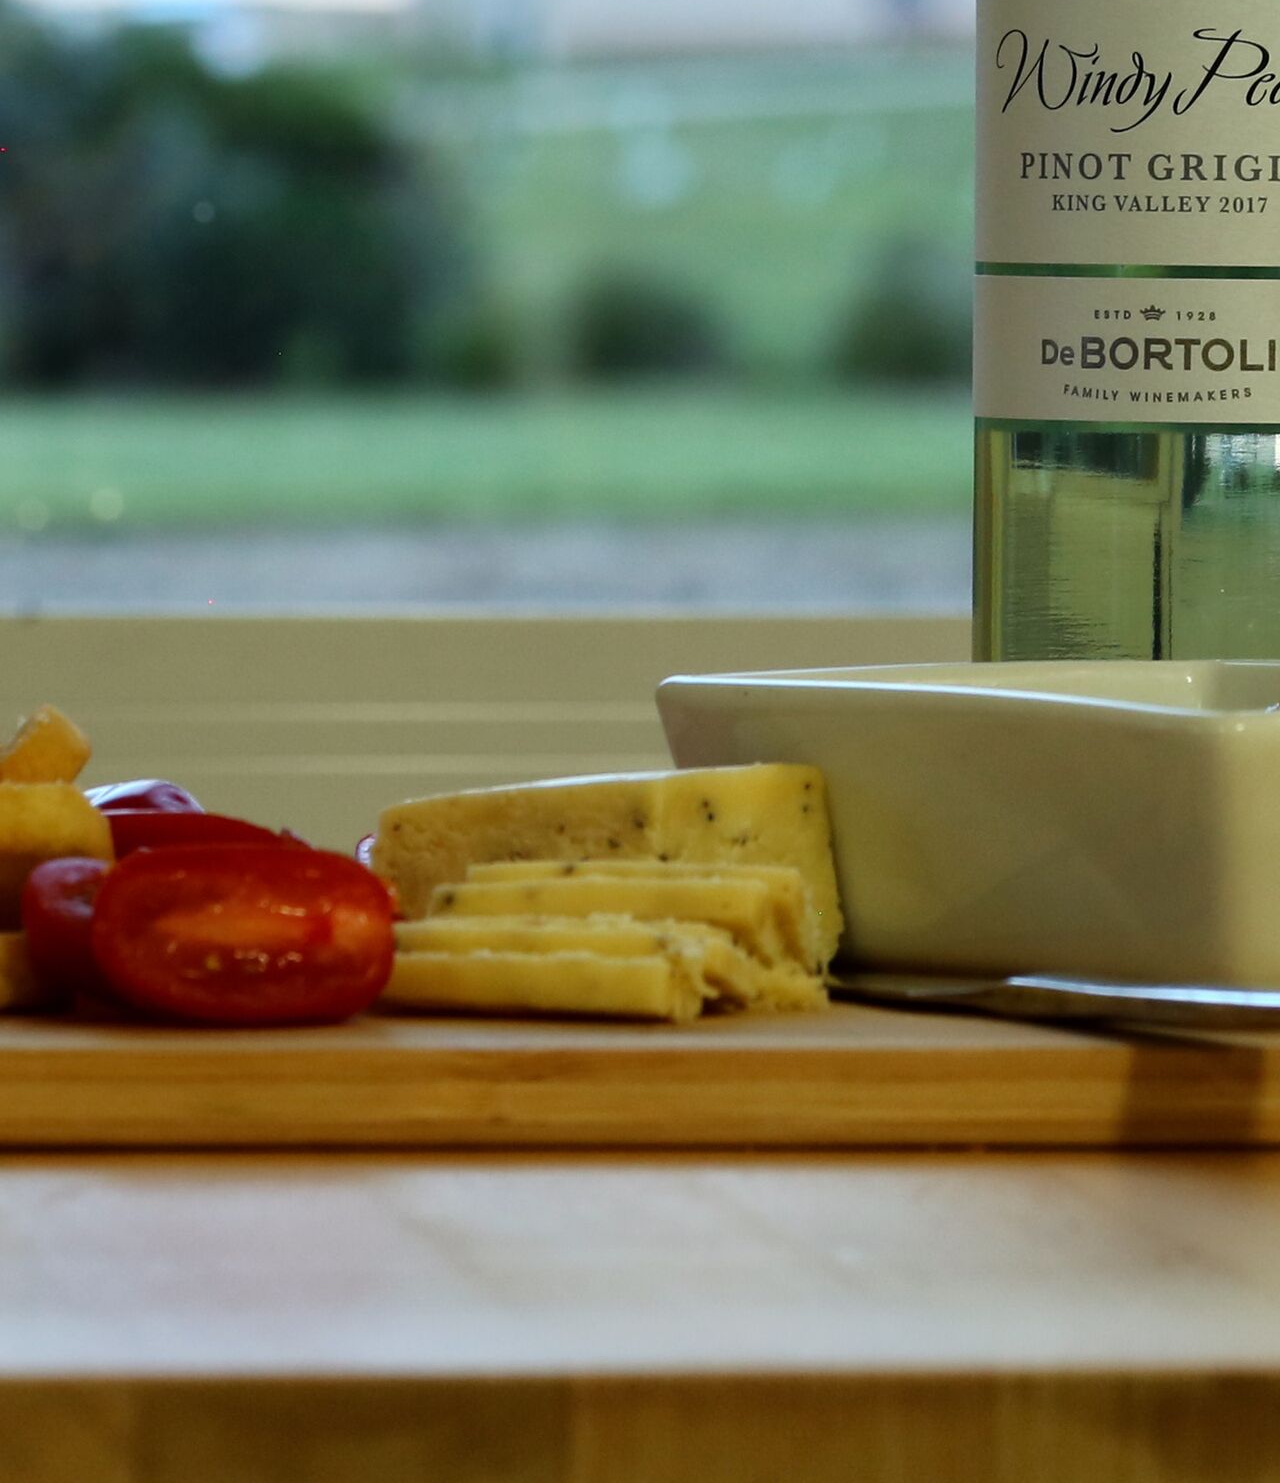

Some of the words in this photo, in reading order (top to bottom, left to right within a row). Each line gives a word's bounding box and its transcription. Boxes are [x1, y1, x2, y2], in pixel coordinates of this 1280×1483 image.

[997, 29, 1172, 133] Windy
[1020, 152, 1132, 180] PINOT
[1052, 194, 1106, 212] KING
[1114, 195, 1211, 213] VALLEY
[1219, 196, 1268, 214] 2017
[1094, 309, 1132, 320] ESTD
[1176, 311, 1217, 321] 1928
[1063, 384, 1120, 402] FAMILY
[1130, 387, 1253, 404] WINEMAKERS
